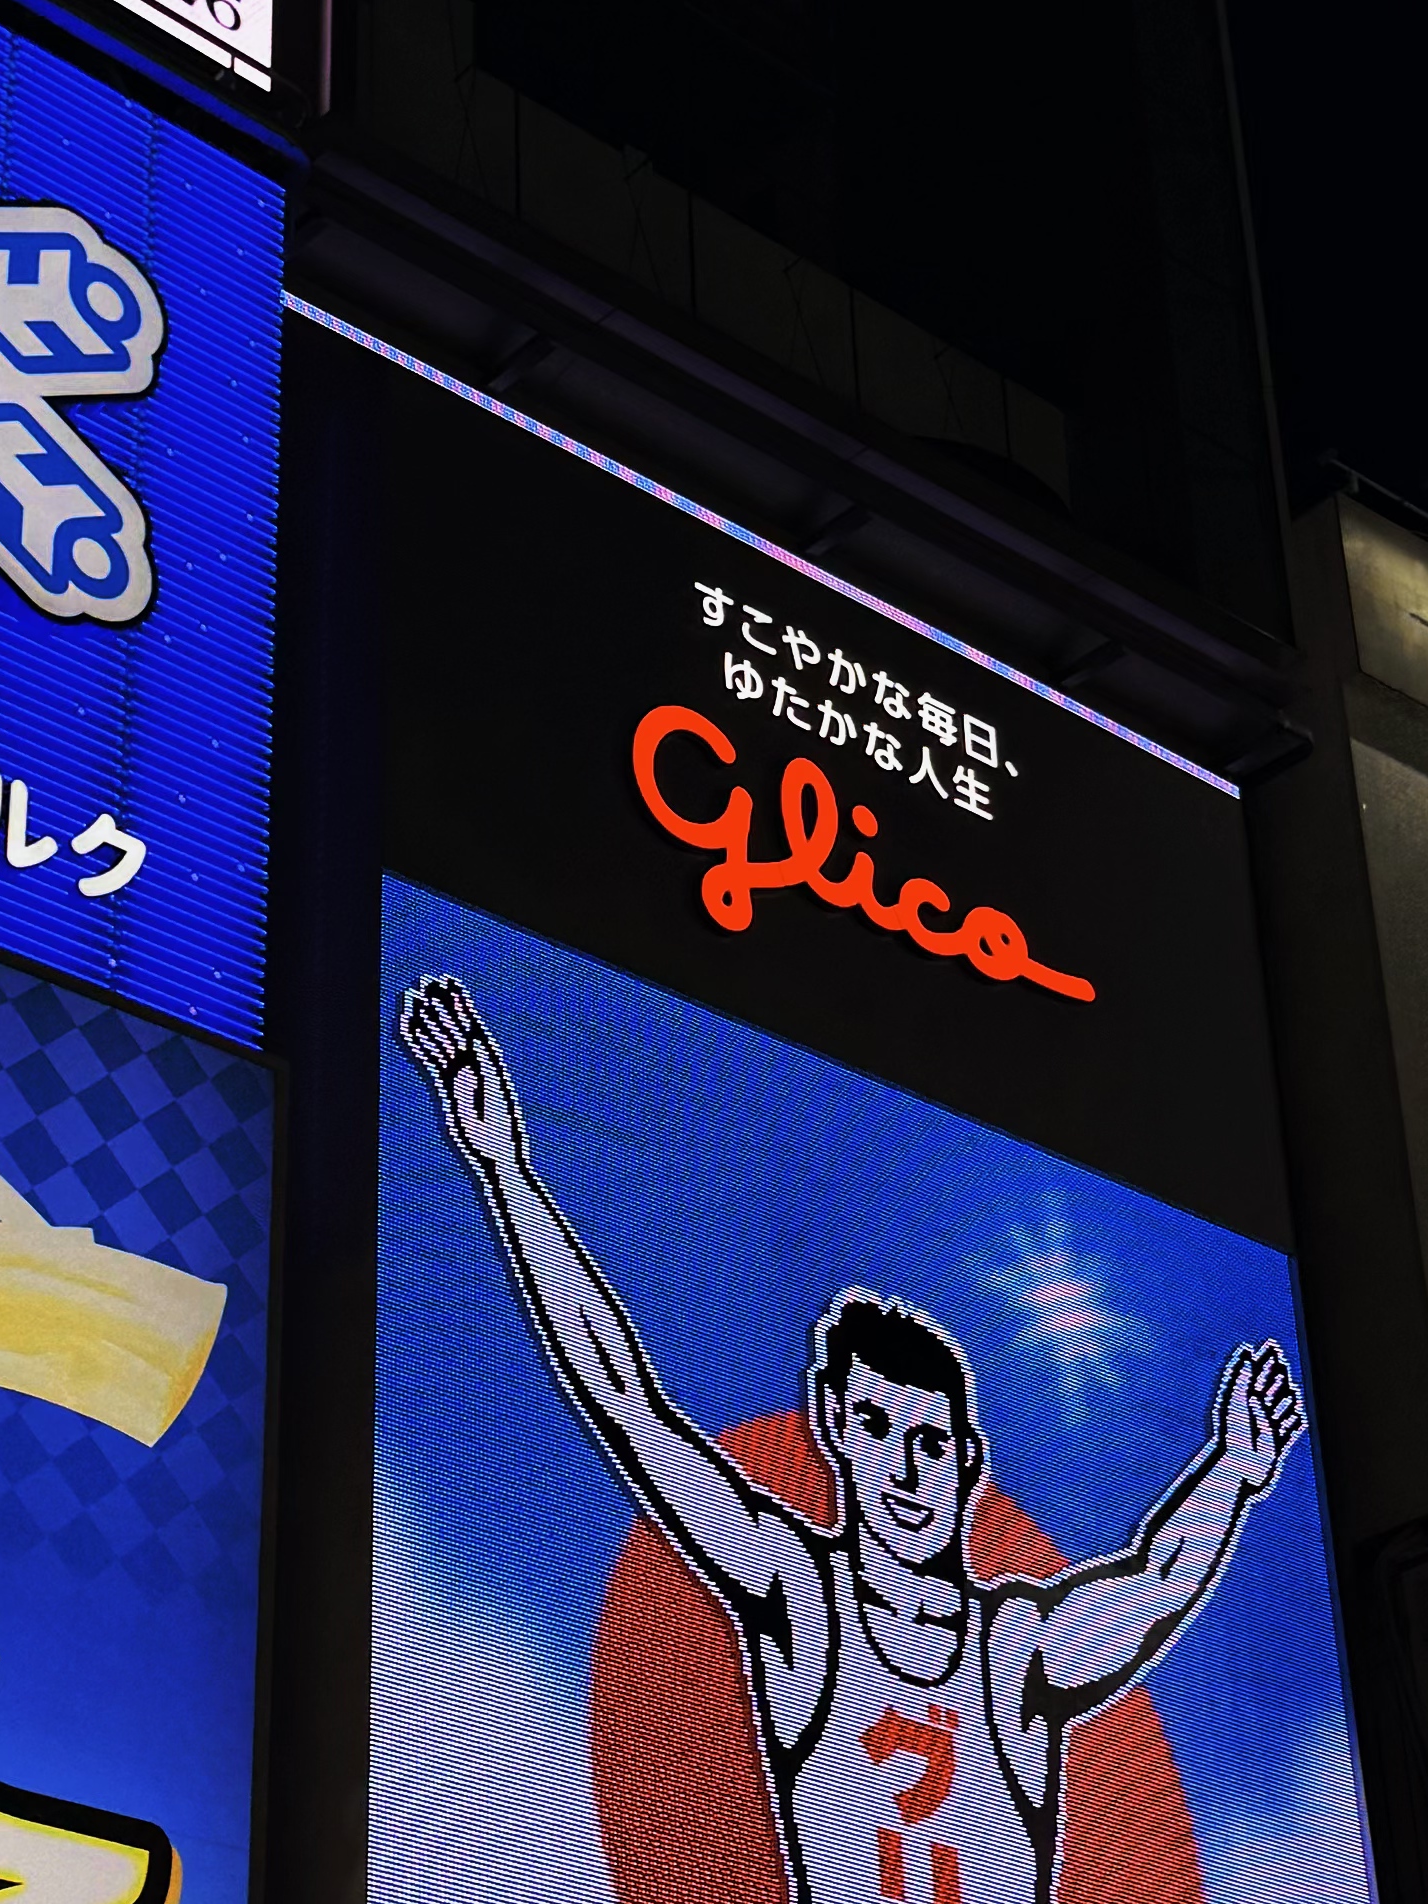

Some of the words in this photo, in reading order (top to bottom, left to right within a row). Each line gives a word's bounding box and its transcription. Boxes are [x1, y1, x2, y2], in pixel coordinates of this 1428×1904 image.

[694, 581, 1018, 777] すこやかな毎日、
[724, 652, 993, 821] ゆたかな人生
